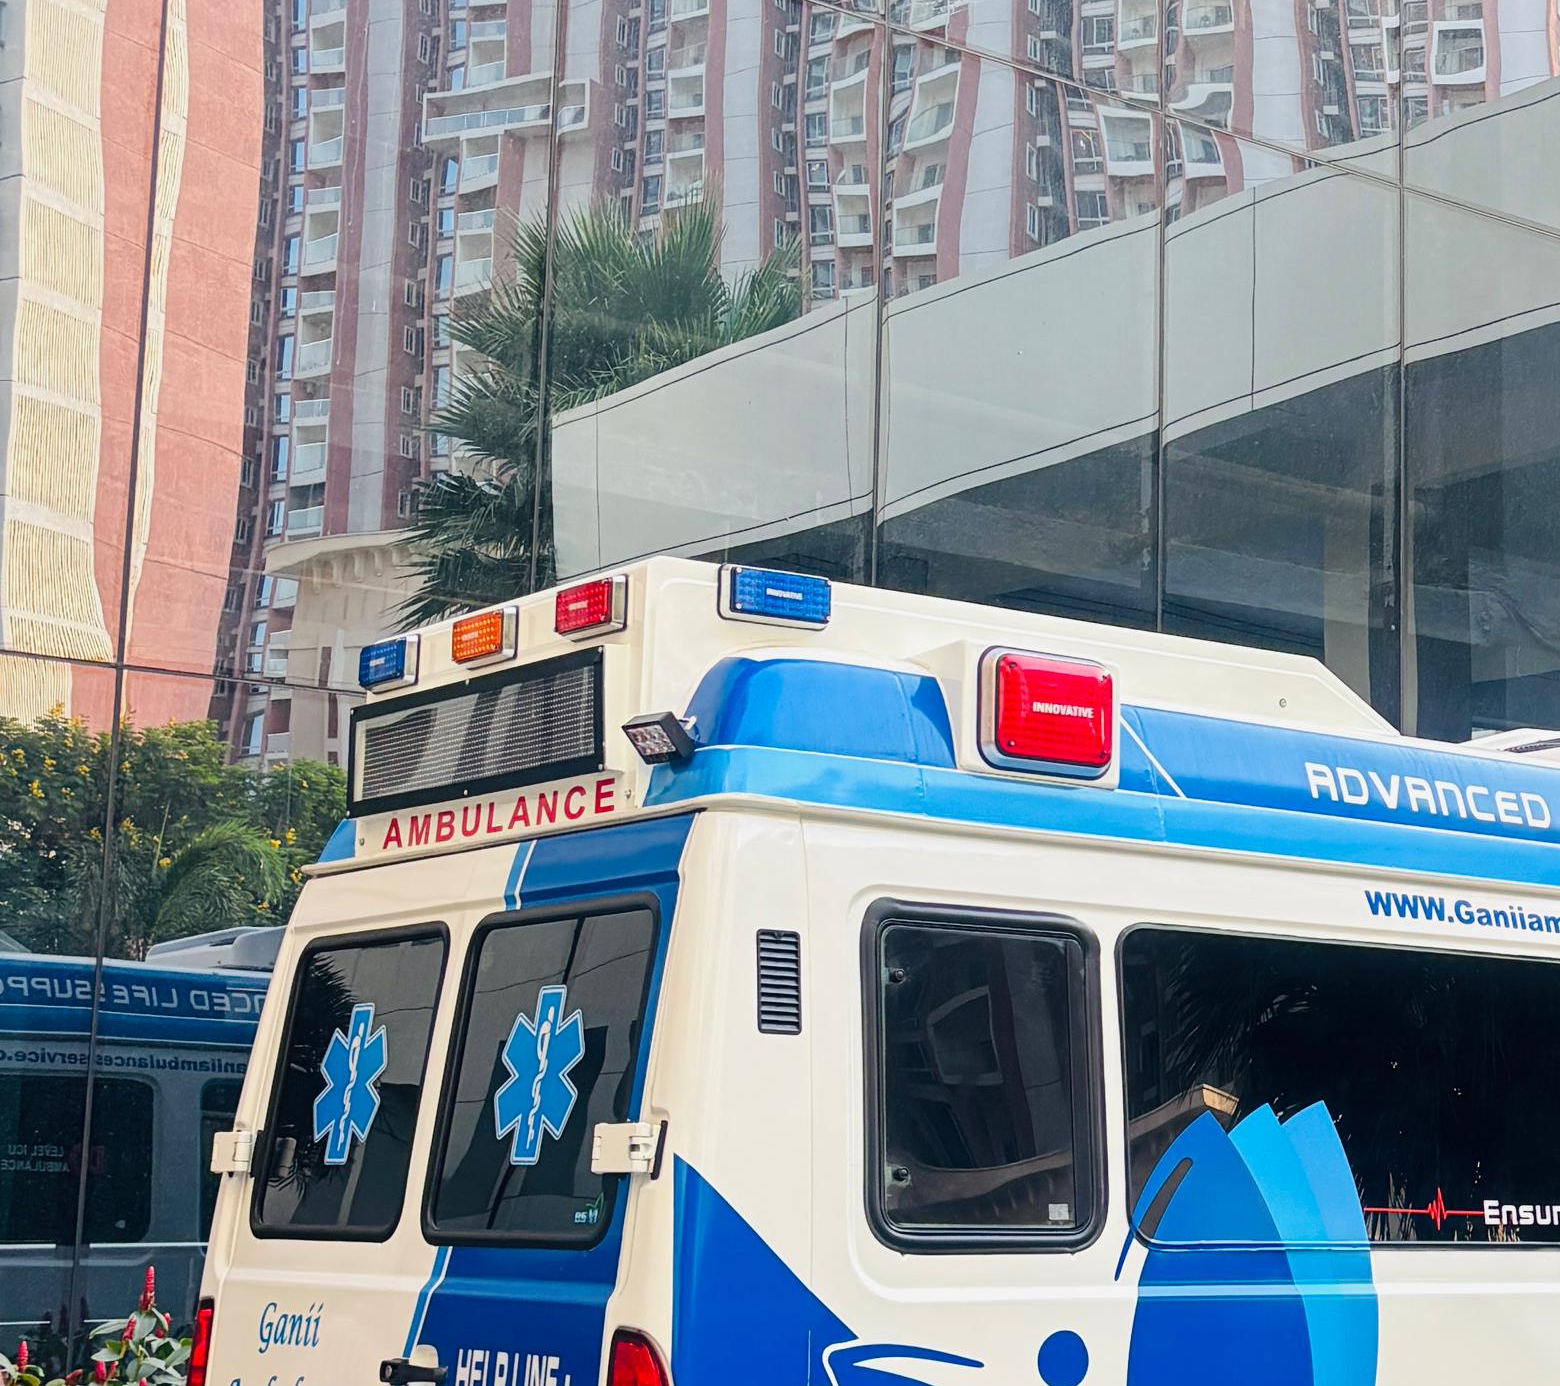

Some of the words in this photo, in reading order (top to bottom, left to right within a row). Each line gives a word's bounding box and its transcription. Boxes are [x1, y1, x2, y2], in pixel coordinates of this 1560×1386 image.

[1032, 701, 1094, 719] INNOVATIVE
[383, 778, 615, 850] AMBULANCE
[1304, 761, 1551, 829] ADVANCED
[258, 1301, 324, 1354] Ganii
